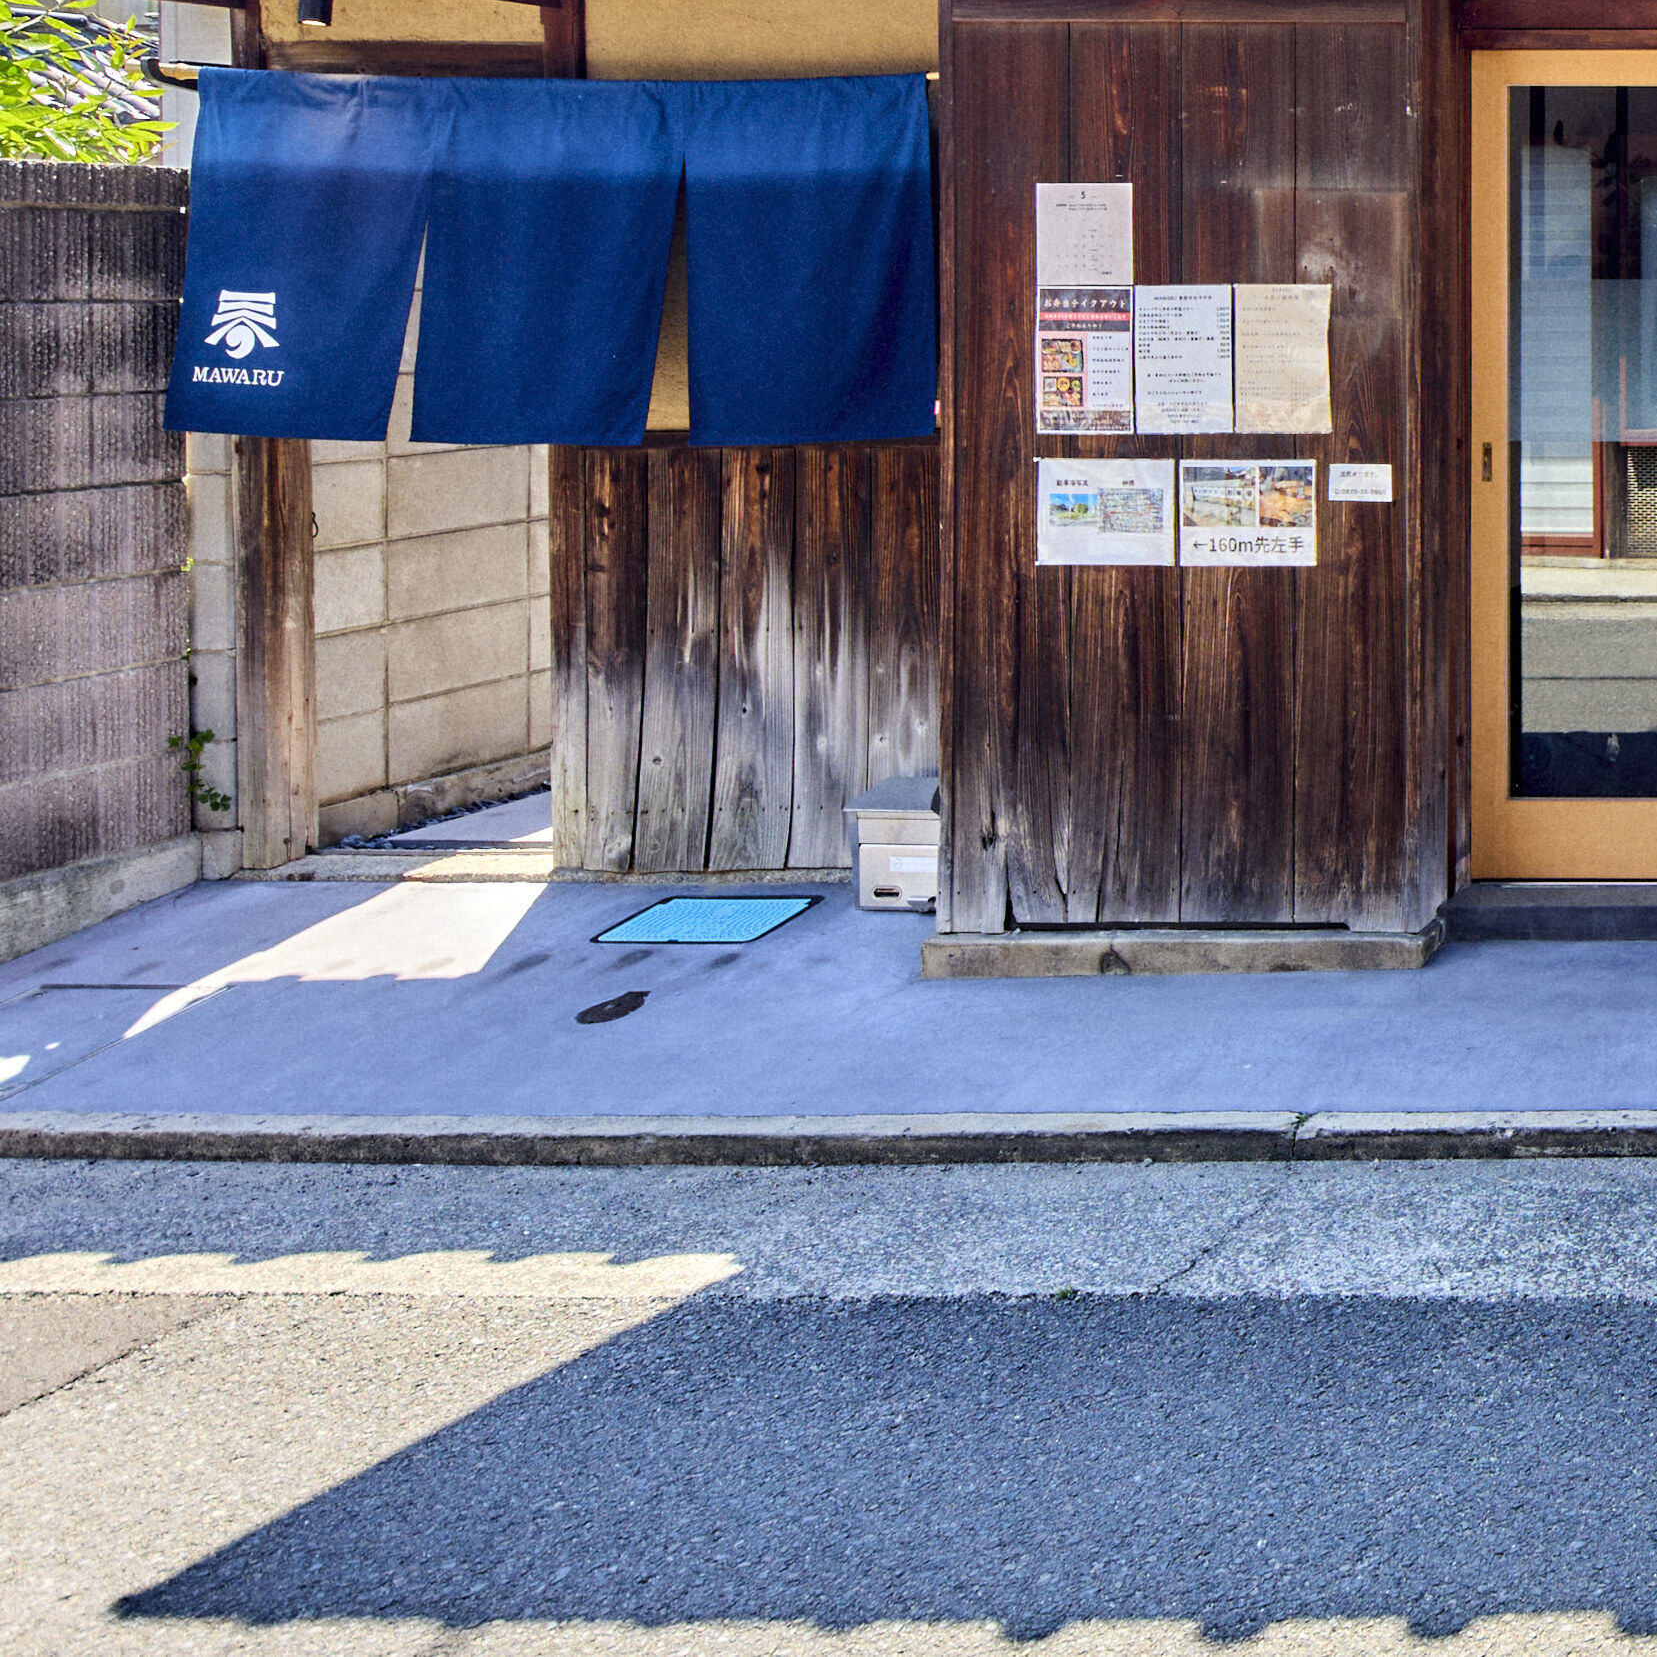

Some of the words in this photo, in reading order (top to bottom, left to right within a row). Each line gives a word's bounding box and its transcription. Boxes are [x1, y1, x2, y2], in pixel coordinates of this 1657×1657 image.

[1081, 191, 1086, 200] 5
[1044, 298, 1126, 309] お弁当テイクアウト
[192, 366, 285, 387] MAWARU
[1209, 535, 1305, 554] 160m先左手
